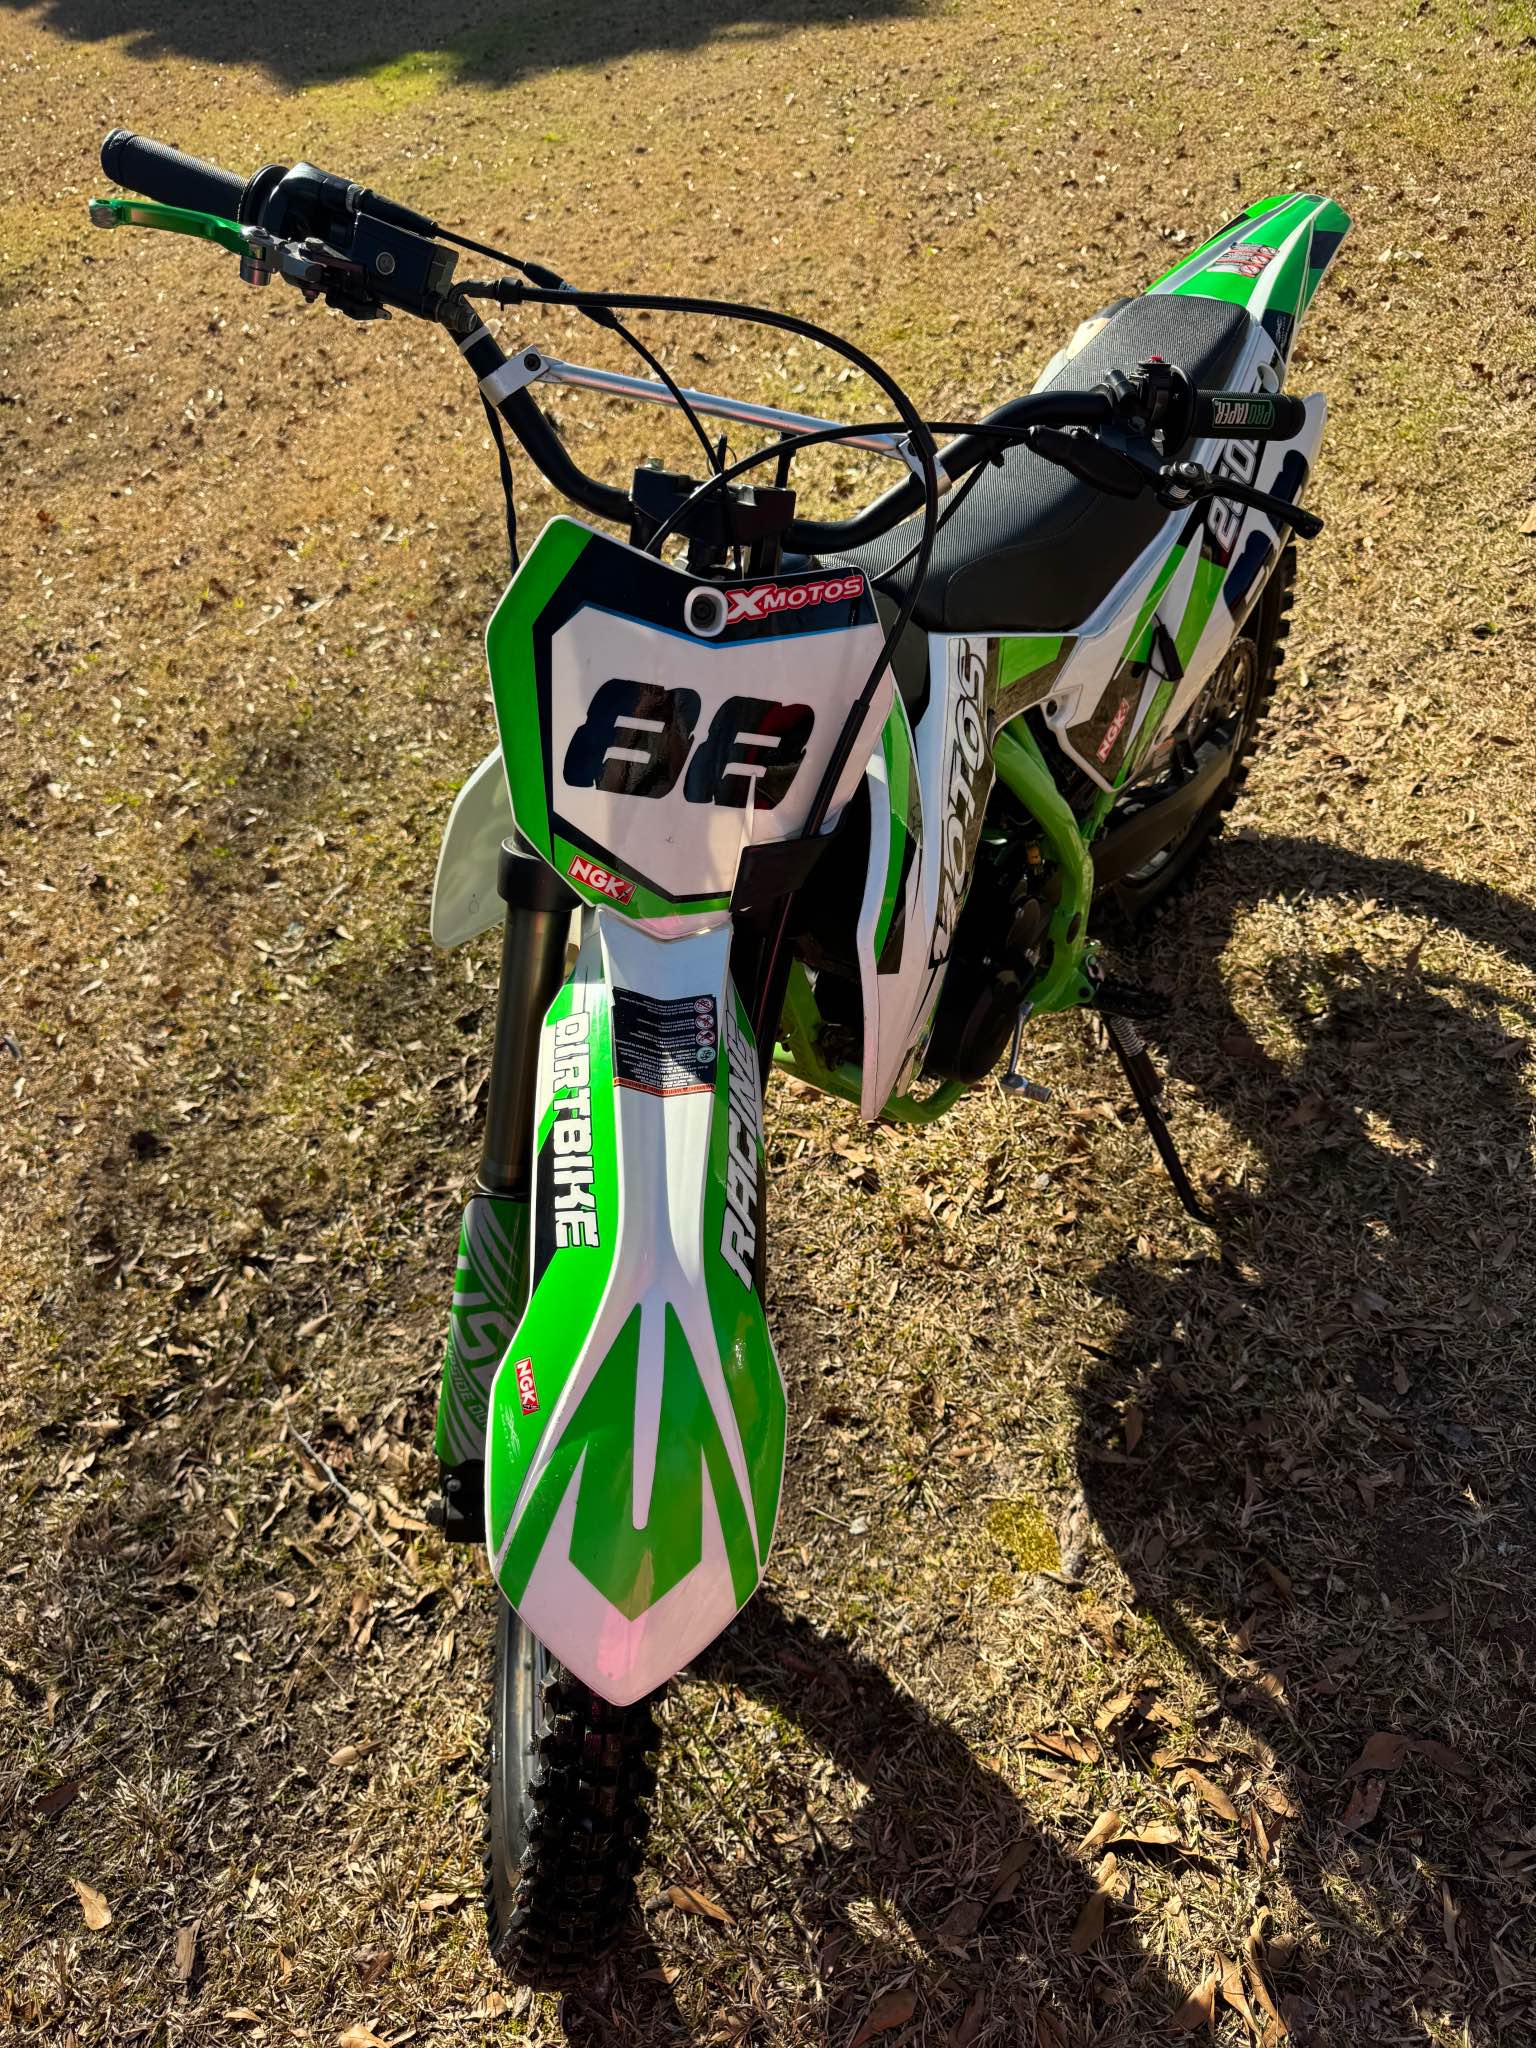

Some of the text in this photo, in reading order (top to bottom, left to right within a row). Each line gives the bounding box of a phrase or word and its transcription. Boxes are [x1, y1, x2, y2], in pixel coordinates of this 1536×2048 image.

[728, 578, 860, 620] XMOTOS
[563, 678, 815, 810] 88
[1099, 709, 1126, 759] NGK
[570, 857, 625, 899] NGK
[552, 1011, 600, 1248] DIRTBIKE
[720, 1009, 761, 1292] RACING
[516, 1360, 536, 1405] NGK
